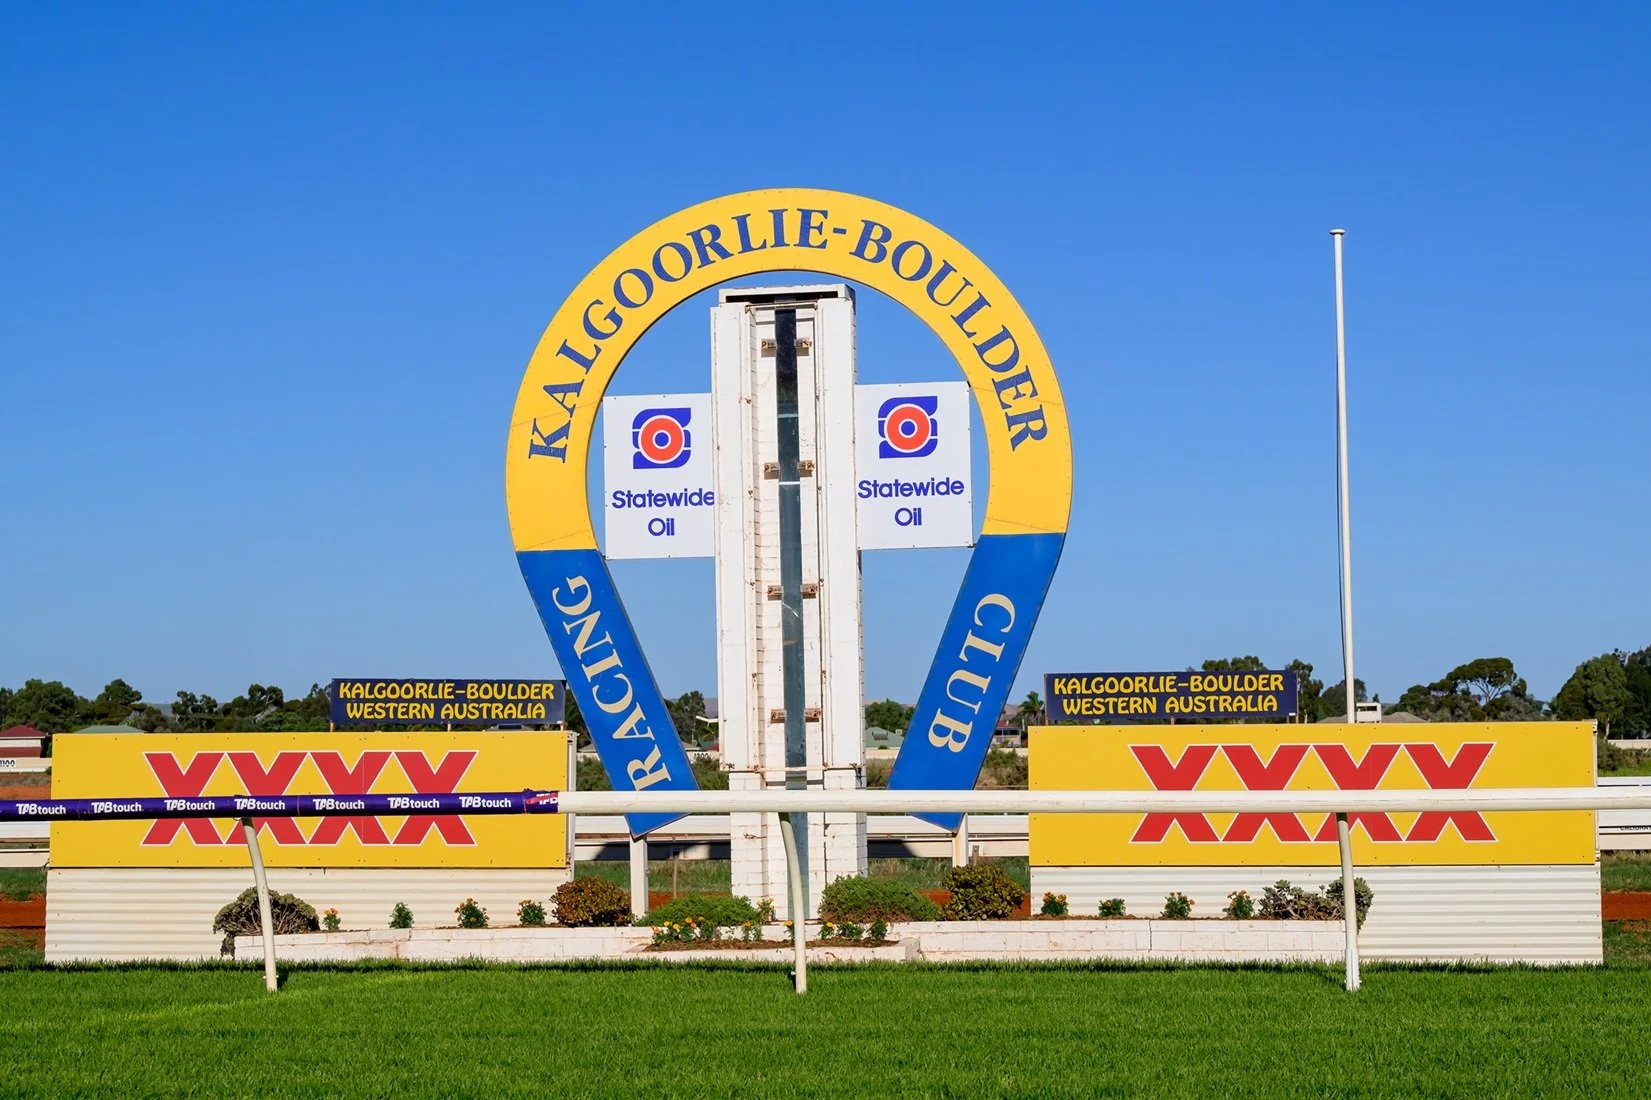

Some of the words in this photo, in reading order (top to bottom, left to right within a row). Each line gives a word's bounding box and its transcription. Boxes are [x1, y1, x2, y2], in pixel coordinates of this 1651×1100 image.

[527, 208, 1048, 464] KALGOORLIE-BOULDER
[858, 477, 964, 498] Statewide
[612, 488, 714, 509] Statewide
[648, 518, 675, 536] Oil
[894, 507, 922, 526] Oil
[552, 575, 672, 790] RACING
[927, 593, 1016, 753] CLUB
[339, 682, 555, 700] KALGOORLIE-BOULDER
[1054, 674, 1284, 695] KALGOORLIE-BOULDER
[346, 702, 434, 719] WESTERN
[440, 702, 546, 719] AUSTRALIA
[1062, 696, 1157, 715] WESTERN
[1165, 694, 1278, 713] AUSTRALIA
[141, 750, 480, 847] XXXX
[1128, 742, 1498, 844] XXXX
[16, 803, 66, 815] TABtouch
[91, 802, 142, 813] TABtouch
[164, 799, 215, 811] TABtouch
[234, 798, 285, 810] TABtouch
[313, 798, 364, 810] TABtouch
[387, 797, 439, 809] TABtouch
[459, 796, 511, 808] TABtouch
